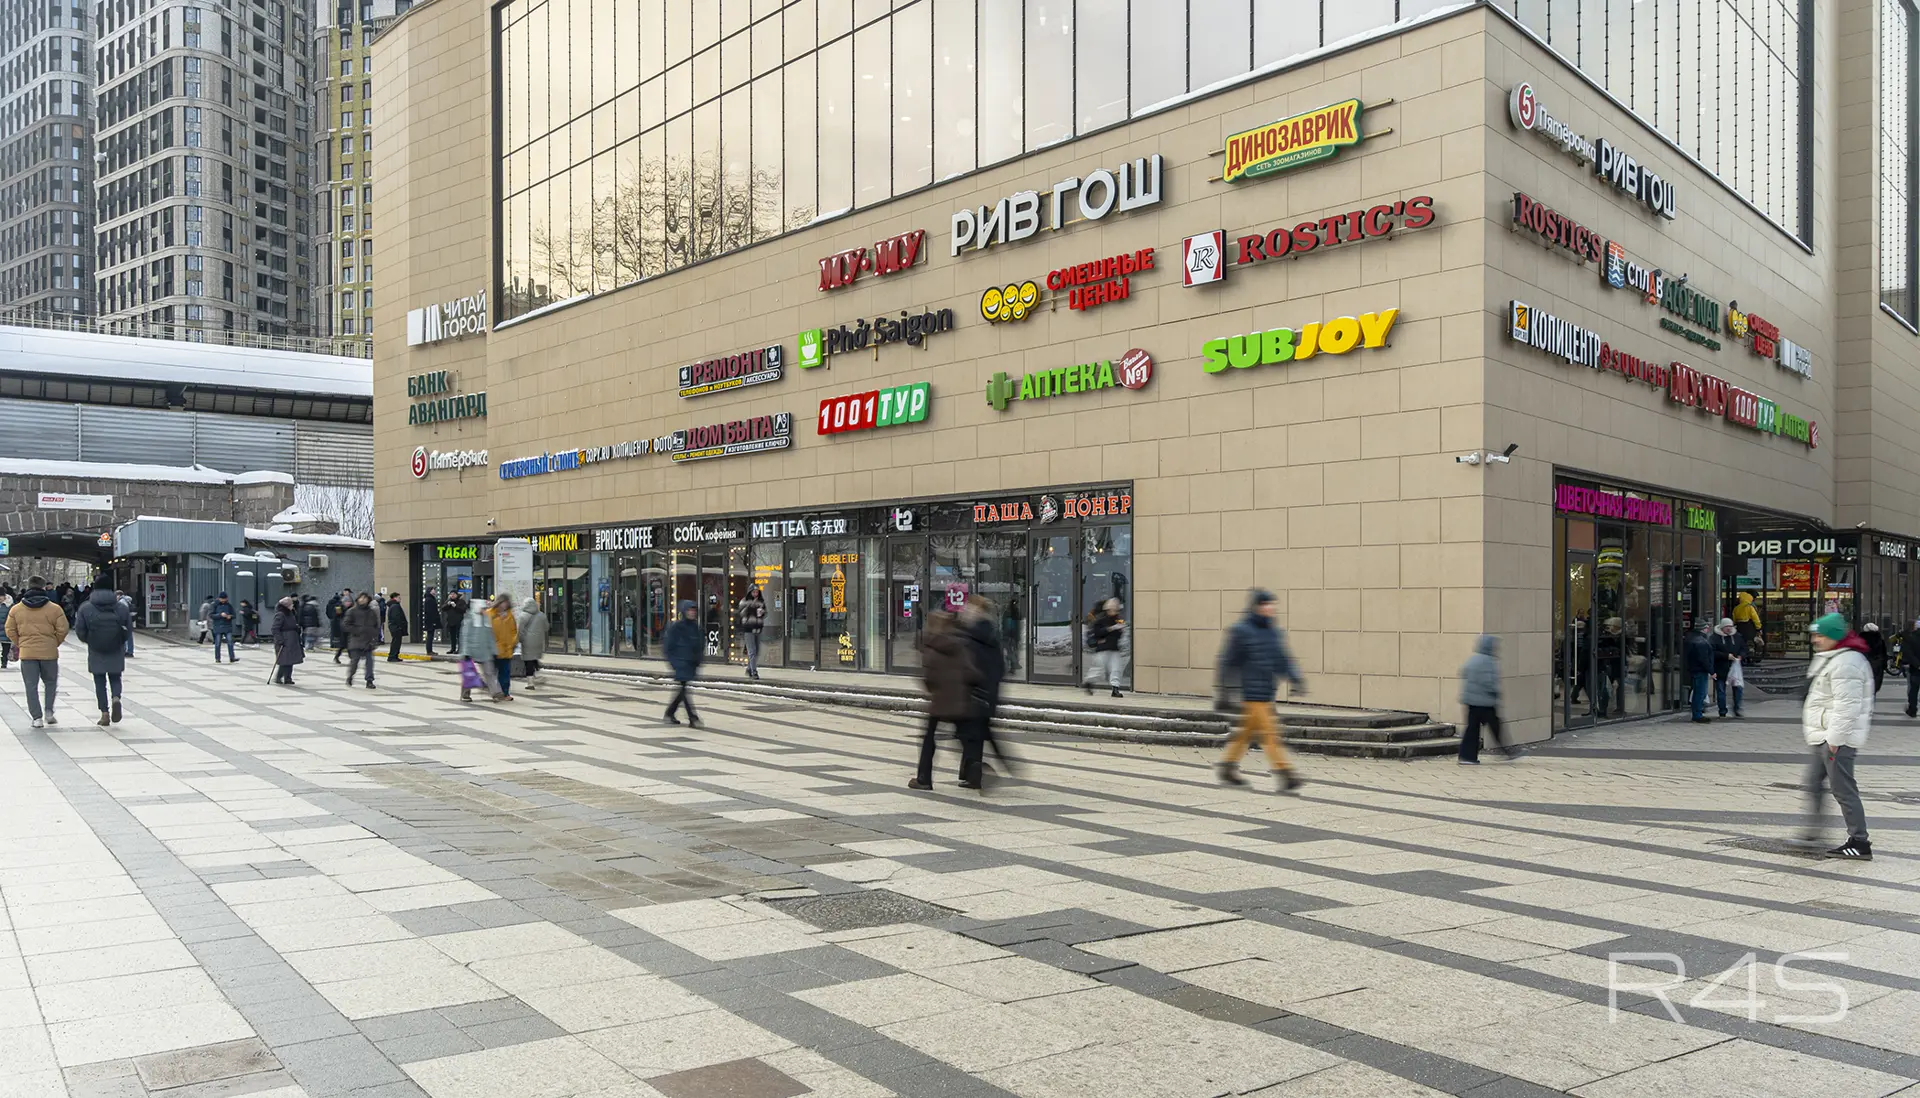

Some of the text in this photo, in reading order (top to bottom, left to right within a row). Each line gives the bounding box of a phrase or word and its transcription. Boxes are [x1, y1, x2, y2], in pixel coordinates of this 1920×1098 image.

[1226, 104, 1354, 177] ДИНОЗАВРИК
[1255, 147, 1322, 171] СЕТЬ ЗООМАГАЗИНОВ
[1599, 137, 1676, 220] РИВ ГОШ
[951, 154, 1163, 257] РИВ ГОШ
[1237, 196, 1434, 265] ROSTIC'S
[1519, 193, 1602, 264] ROSTIC'S
[1046, 247, 1155, 291] СМЕШНЫЕ
[1627, 261, 1664, 299] СПЛАВ
[444, 288, 486, 319] ЧИТАЙ
[1069, 277, 1130, 311] ЦЕНЫ
[443, 312, 487, 339] ГОРОД
[873, 306, 954, 346] Saigon
[1531, 307, 1601, 369] КОПИЦЕНТР
[407, 369, 449, 397] БАНК
[693, 348, 764, 386] РЕМОНТ
[746, 371, 778, 383] АКСЕССУАРЫ
[1019, 360, 1115, 401] АПТЕКА
[1613, 349, 1669, 388] SUNLIGHT
[408, 391, 487, 425] АВАНГАРД
[821, 396, 875, 430] 1001
[612, 440, 650, 459] КОПИЦЕНТР
[653, 435, 672, 452] ФОТО
[685, 415, 772, 450] ДОМ БЫТА
[728, 439, 786, 453] ИЗГОТОВЛЕНИЕ КЛЮЧЕЙ
[973, 502, 1033, 523] ПАША
[1558, 483, 1672, 525] ЦВЕТОЧНАЯ ЯРМАРКА
[1687, 507, 1715, 531] ТАБАК
[600, 526, 653, 551] PRICE COFFEE
[673, 521, 737, 543] cofix кофейня
[752, 519, 807, 538] MET TEA
[436, 545, 478, 560] ТАБАК
[821, 554, 847, 564] BUBBLE
[1737, 538, 1835, 555] РИВ ГОШ
[947, 588, 964, 606] t2
[707, 642, 719, 656] fix
